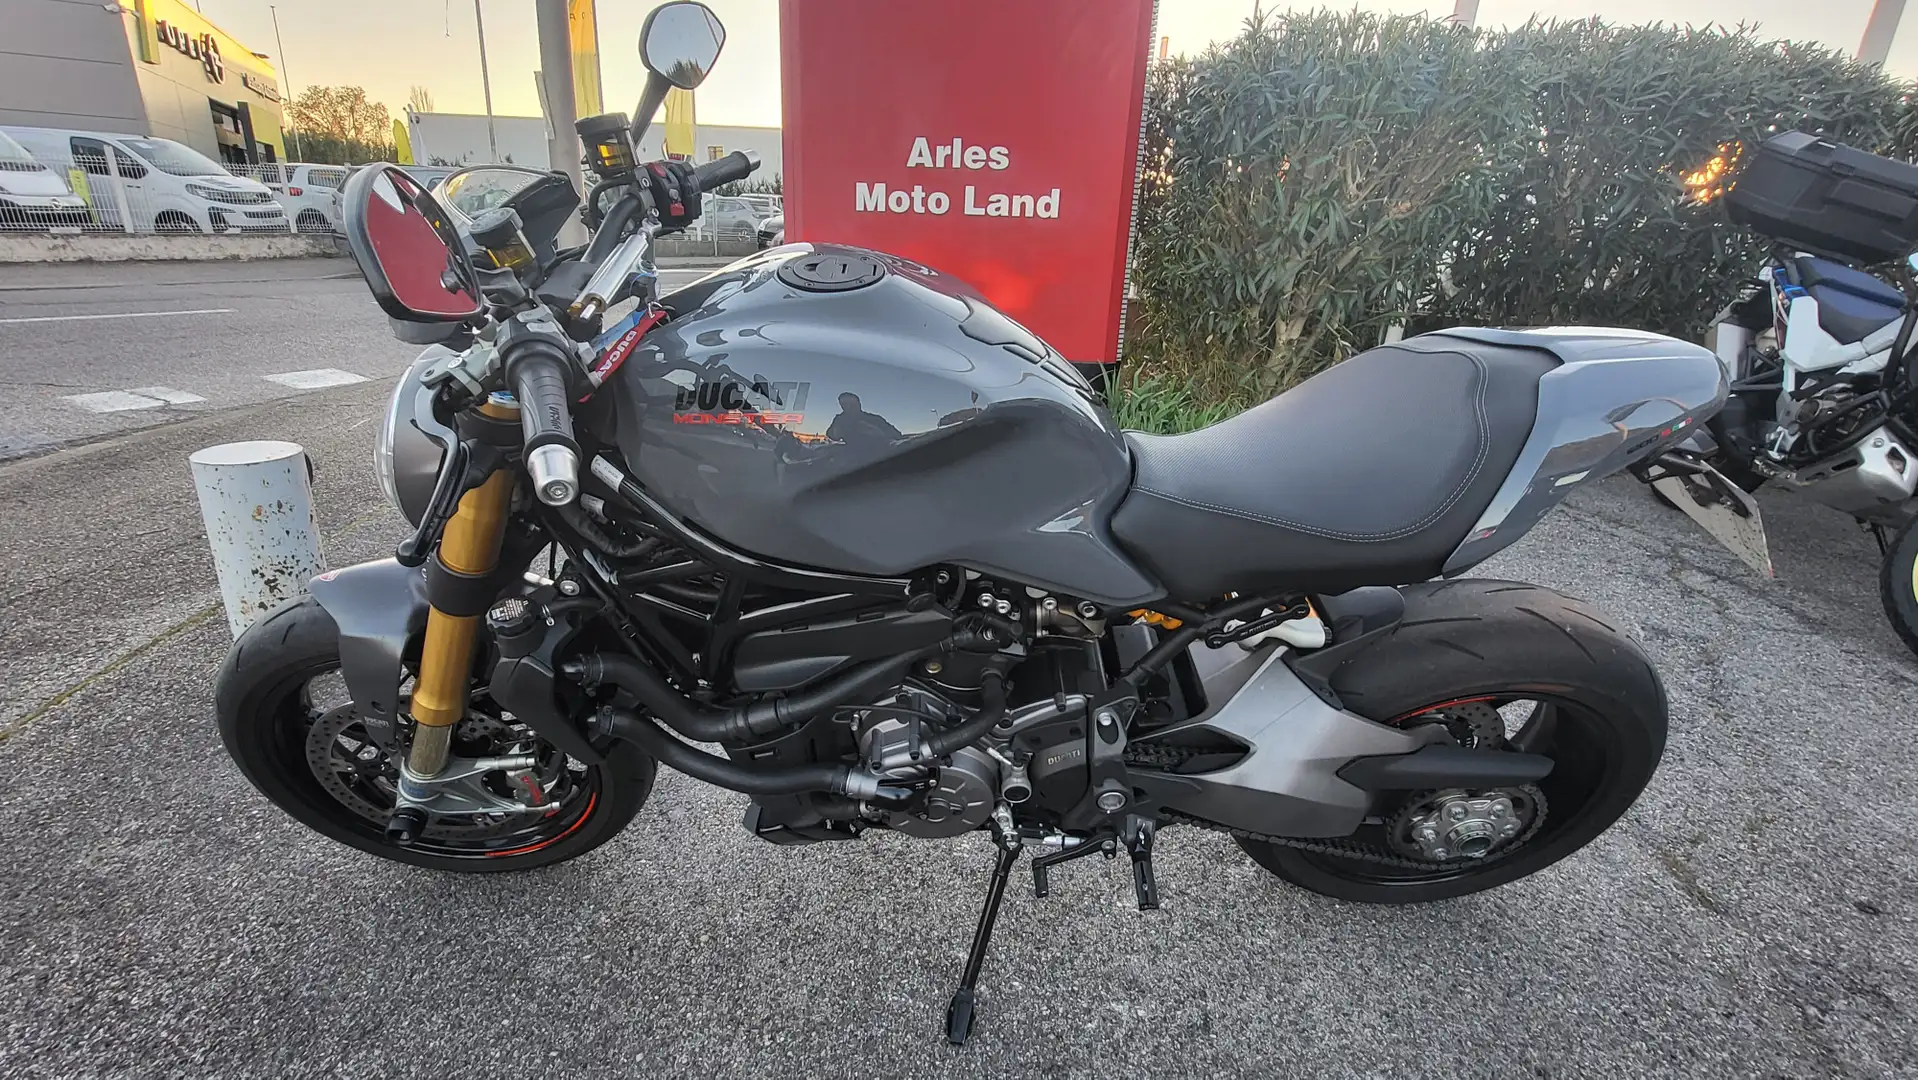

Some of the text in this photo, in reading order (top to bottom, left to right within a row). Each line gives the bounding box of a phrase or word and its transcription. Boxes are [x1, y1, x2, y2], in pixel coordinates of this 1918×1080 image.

[907, 136, 1010, 170] Arles
[855, 181, 1061, 219] Moto Land
[597, 330, 637, 378] DUCAT
[674, 382, 811, 411] DUCATI
[672, 412, 805, 425] MONSTER
